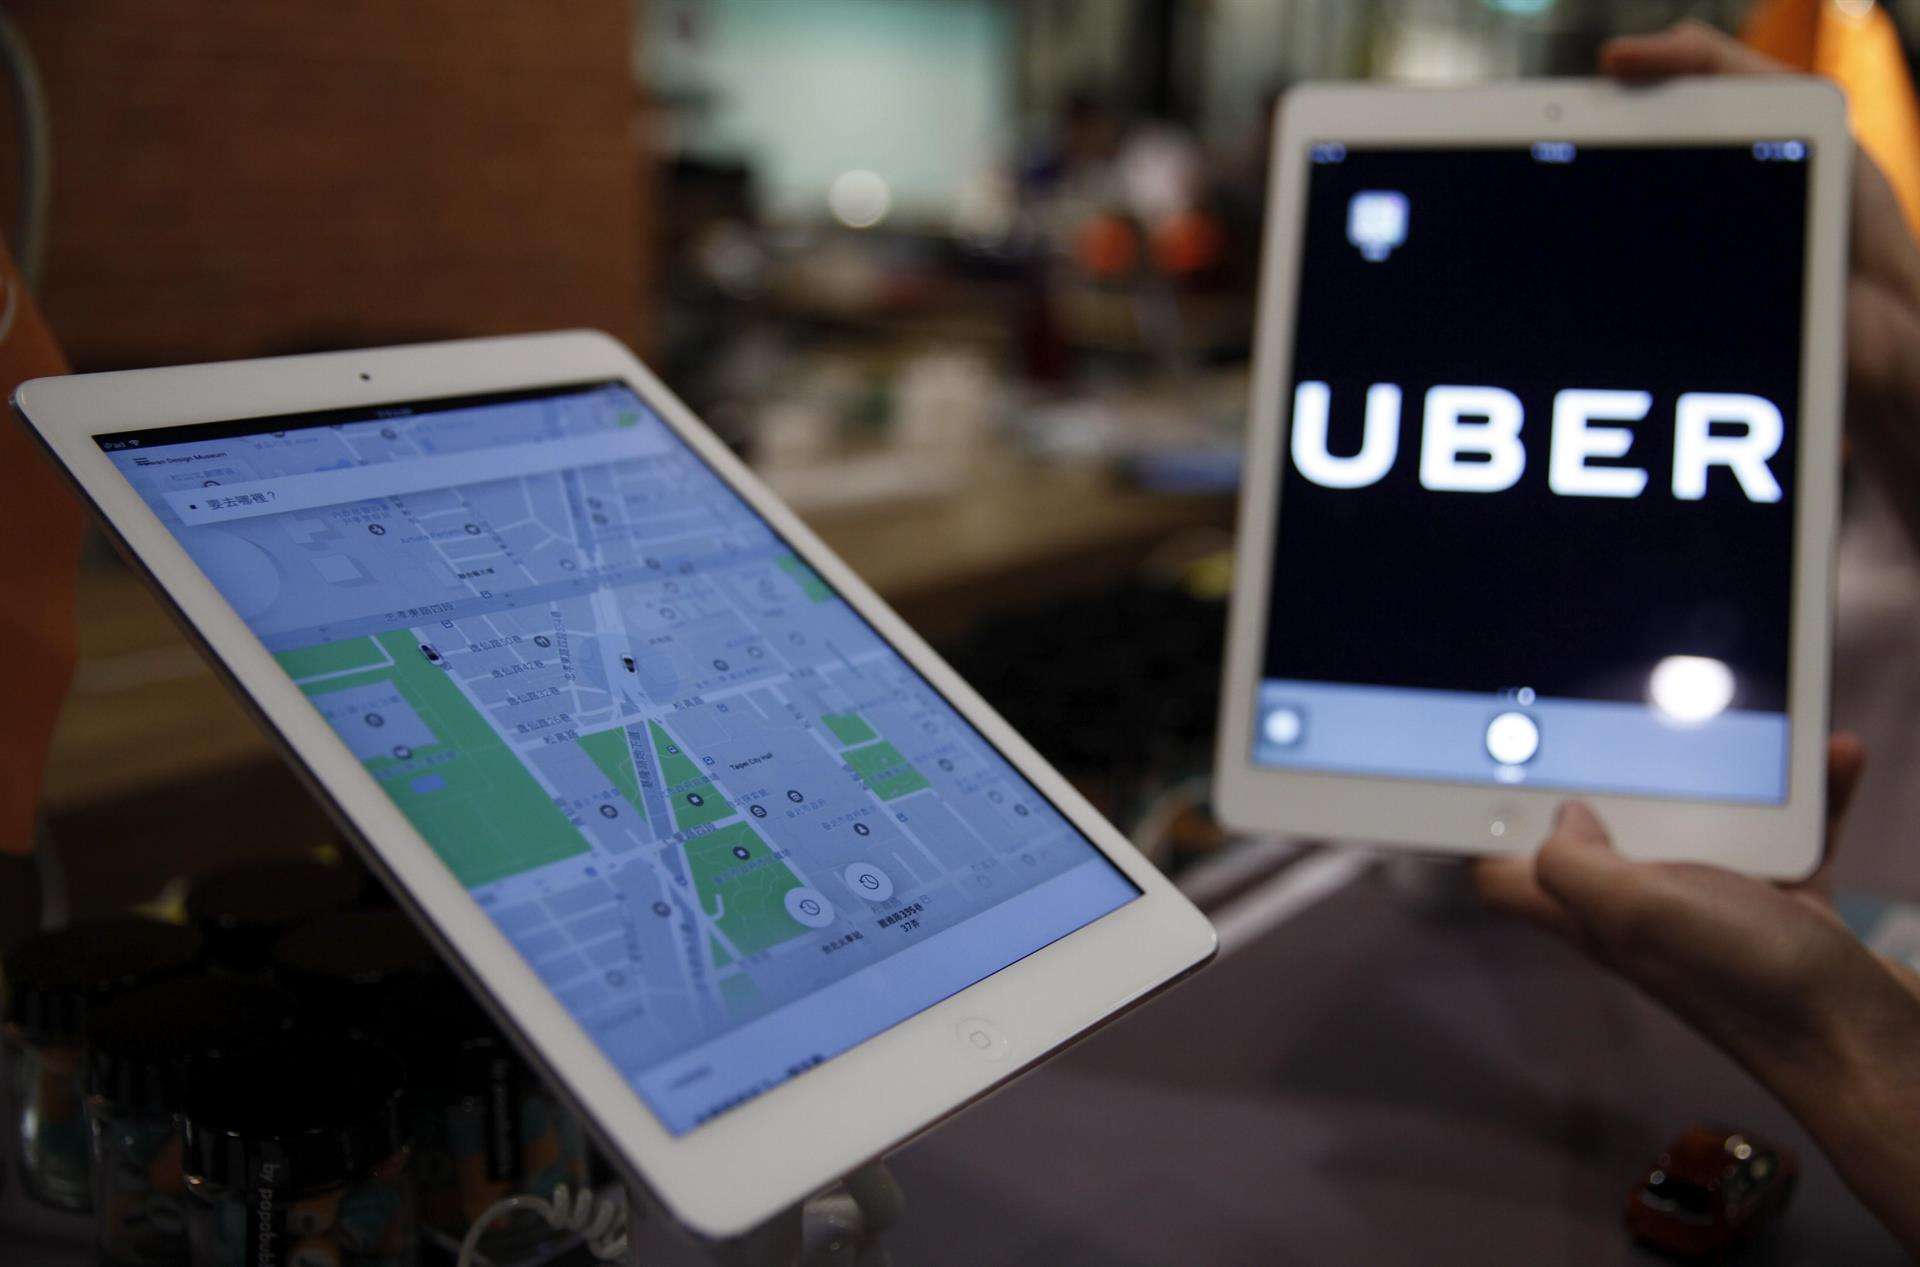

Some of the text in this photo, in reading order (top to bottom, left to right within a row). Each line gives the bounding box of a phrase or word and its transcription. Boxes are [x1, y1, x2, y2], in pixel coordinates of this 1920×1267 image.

[1290, 381, 1784, 503] UBER
[165, 455, 196, 464] Design
[192, 451, 228, 460] Museum
[382, 601, 456, 623] 忠孝東路四段
[467, 634, 524, 653] 逸仙路50巷
[489, 659, 547, 679] 逸仙路42巷
[505, 686, 562, 707] 逸仙路32巷
[670, 695, 706, 711] 松高路
[541, 728, 581, 747] 松高路
[728, 752, 774, 771] Taipei City Hall
[265, 1165, 282, 1187] by
